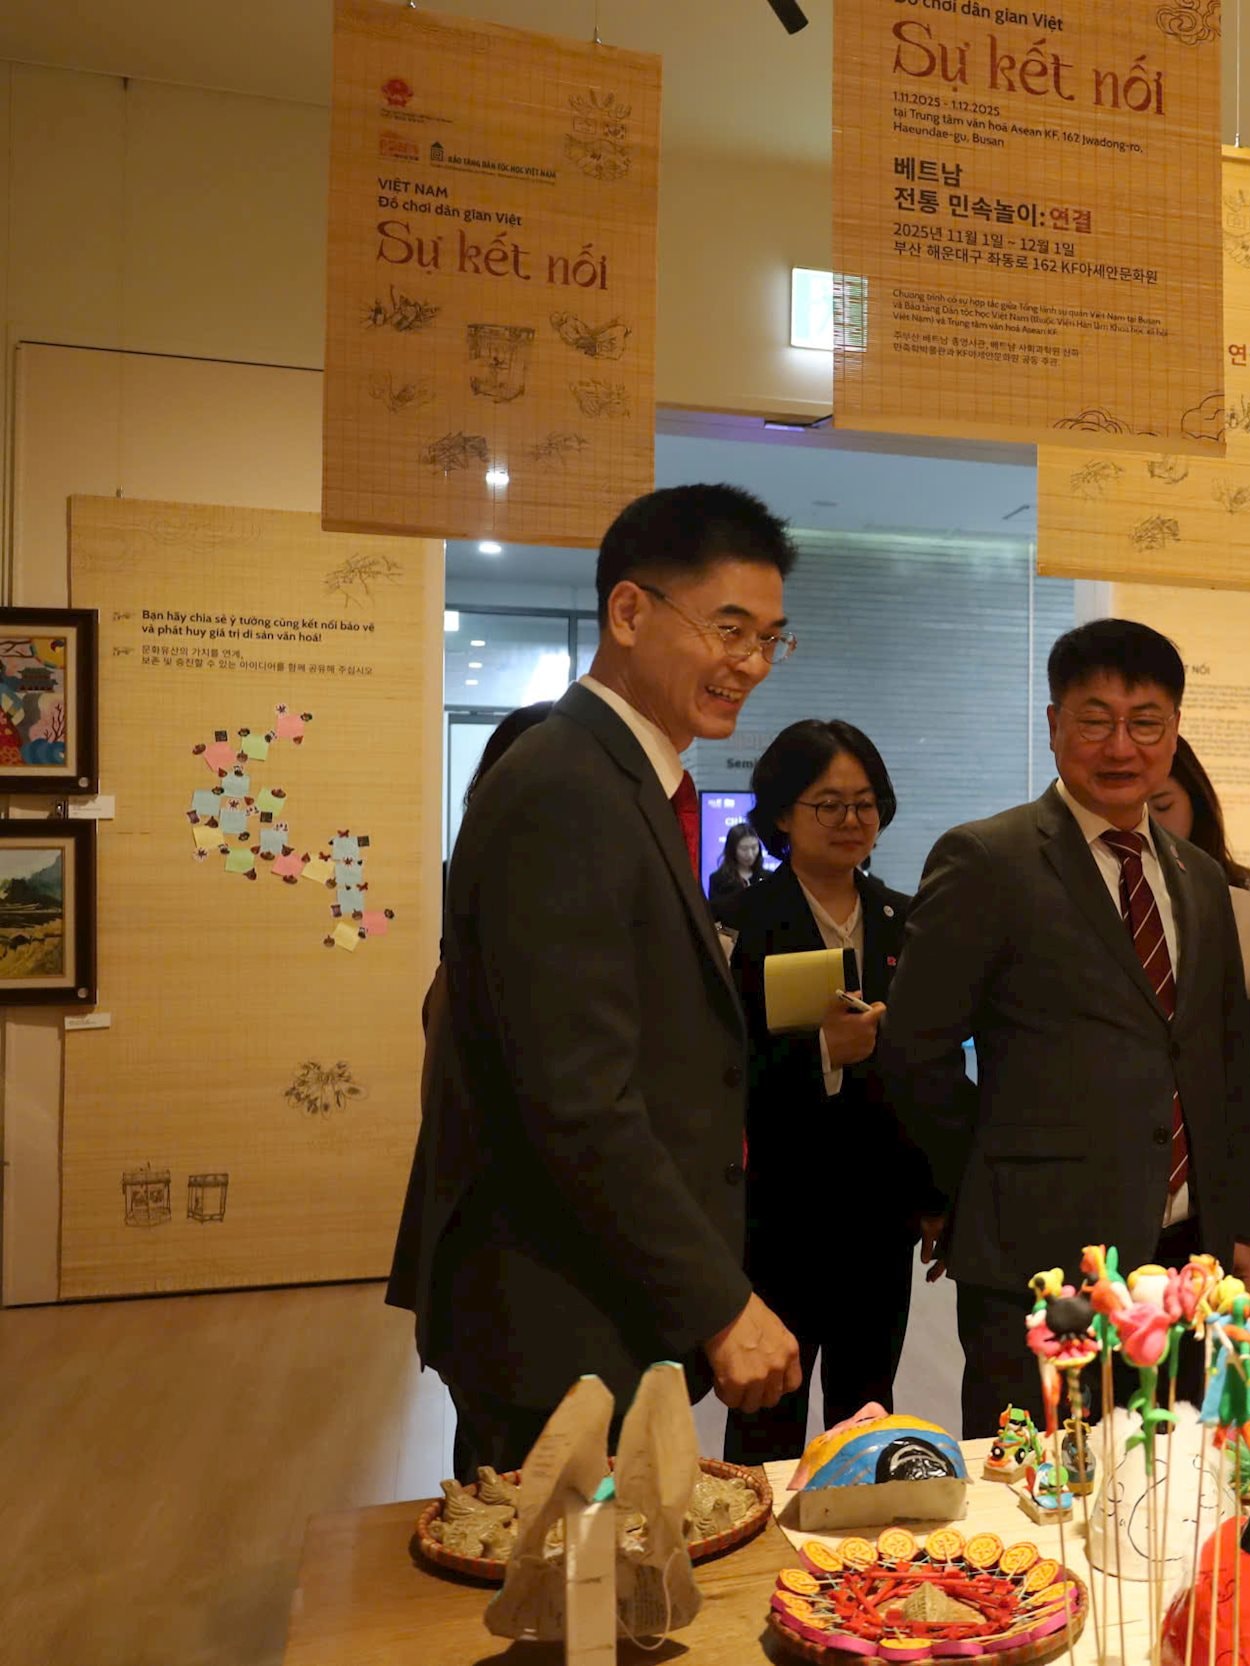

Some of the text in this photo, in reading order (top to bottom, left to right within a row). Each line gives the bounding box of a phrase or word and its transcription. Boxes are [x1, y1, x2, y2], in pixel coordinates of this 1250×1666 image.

[994, 8, 1028, 25] gian
[1031, 13, 1063, 32] Việt
[892, 20, 1165, 116] Sự kết nối
[893, 91, 941, 107] 1.11.2025
[951, 100, 1000, 117] 1.12.2025
[910, 108, 940, 126] Trung
[942, 114, 964, 126] tâm
[966, 119, 985, 130] văn
[1010, 124, 1042, 137] Asean
[1062, 132, 1080, 143] 162
[972, 132, 1005, 147] Busan
[378, 177, 448, 198] VIỆT NAM
[894, 157, 963, 188] 베트남
[378, 195, 522, 226] Đồ chơi dân gian Việt
[893, 187, 940, 215] 전통
[1049, 206, 1093, 234] 연결
[893, 222, 942, 241] 2025년
[947, 229, 977, 246] 11월
[981, 233, 1004, 249] 1일
[1020, 238, 1049, 255] 12월
[1054, 242, 1075, 257] 1일
[377, 221, 608, 290] Sự kết nối
[893, 241, 1158, 285] 부산 해운대구 좌동로 162 KF아세안문화원
[141, 623, 155, 633] và
[157, 624, 183, 636] phát
[185, 625, 206, 639] huy
[209, 628, 225, 640] giá
[228, 629, 240, 640] trị
[242, 629, 253, 639] di
[255, 630, 274, 640] sản
[276, 631, 296, 641] văn
[142, 609, 164, 622] Bạn
[166, 611, 187, 624] hãy
[189, 612, 212, 623] chia
[239, 616, 271, 629] tưởng
[273, 618, 300, 630] cùng
[301, 618, 318, 629] kết
[320, 618, 338, 630] nối
[340, 620, 360, 631] bảo
